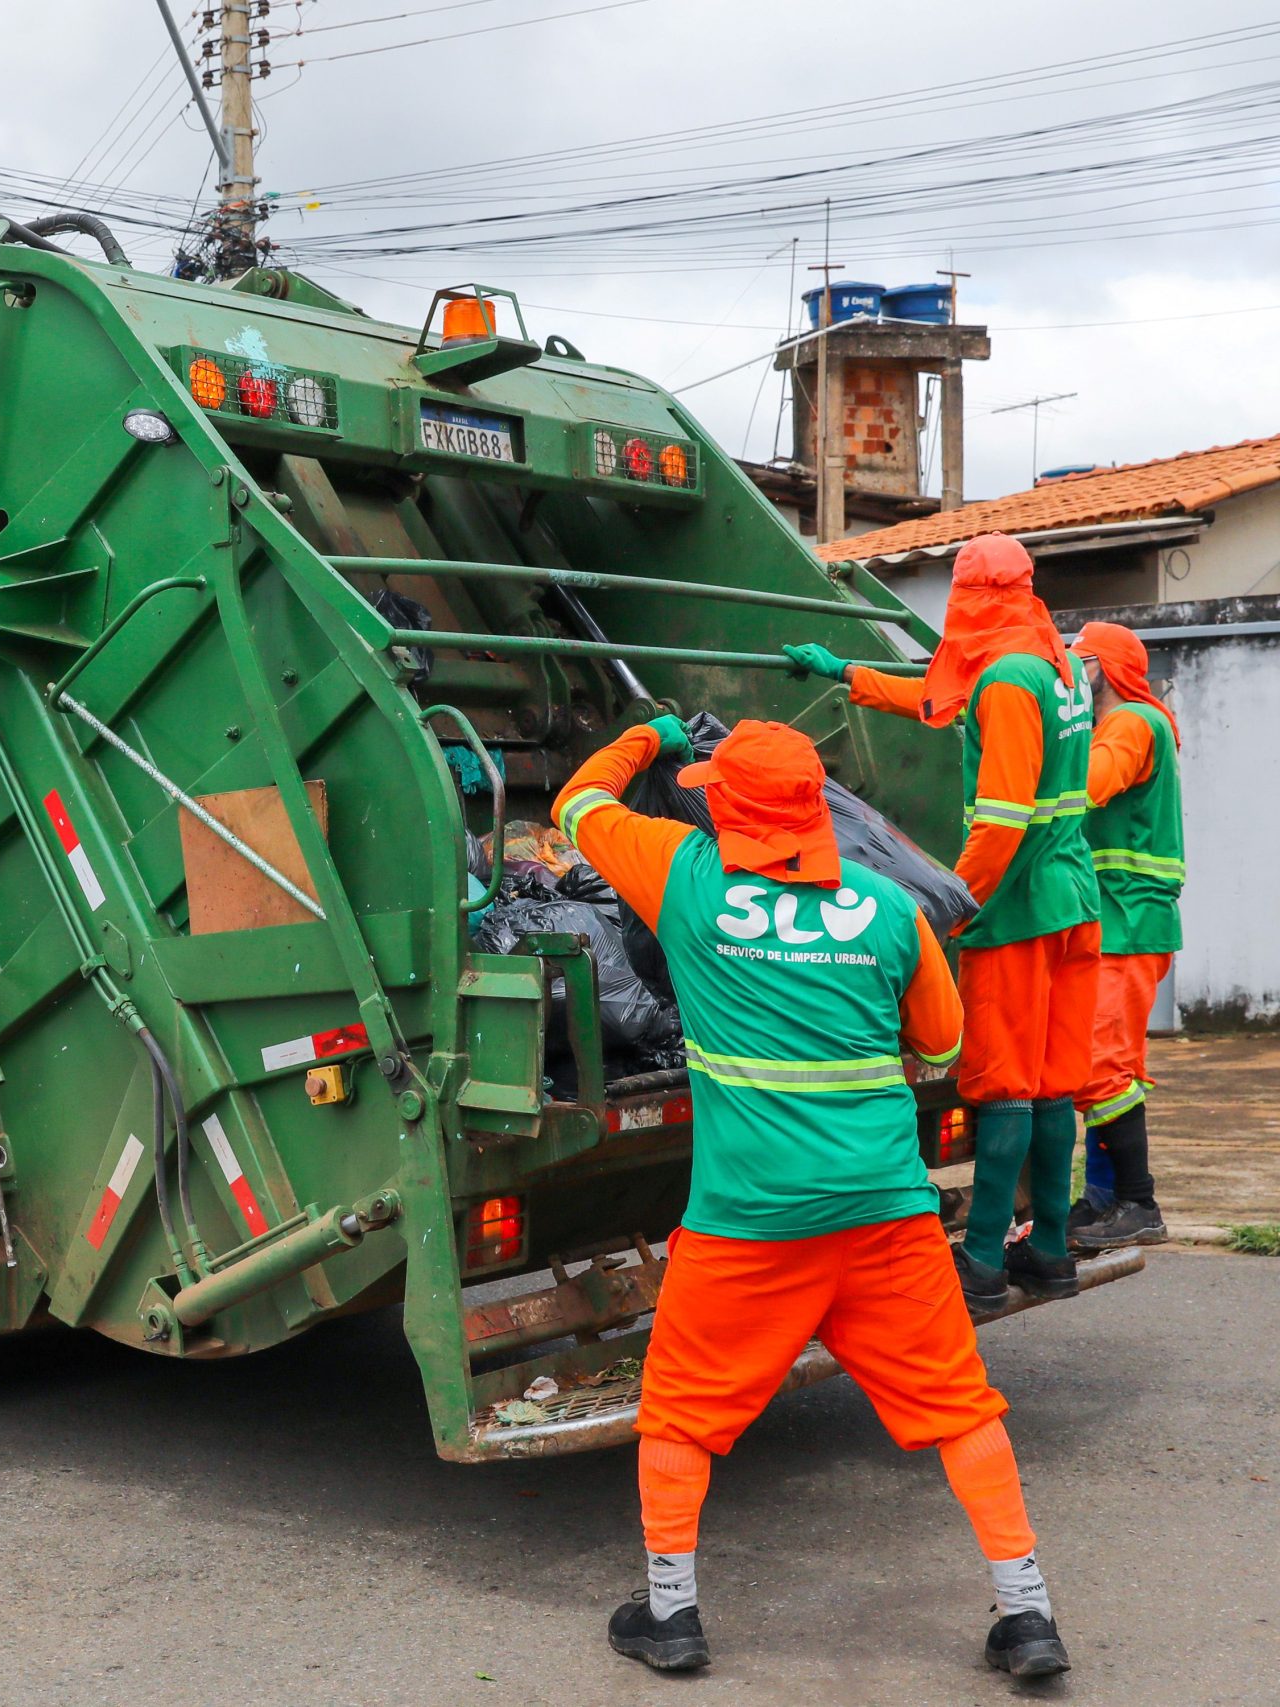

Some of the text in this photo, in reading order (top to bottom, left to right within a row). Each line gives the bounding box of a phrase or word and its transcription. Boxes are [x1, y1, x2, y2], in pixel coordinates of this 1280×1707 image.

[716, 885, 878, 945] SLU
[716, 943, 877, 967] SERVIÇO DE LIMPEZA URBANA
